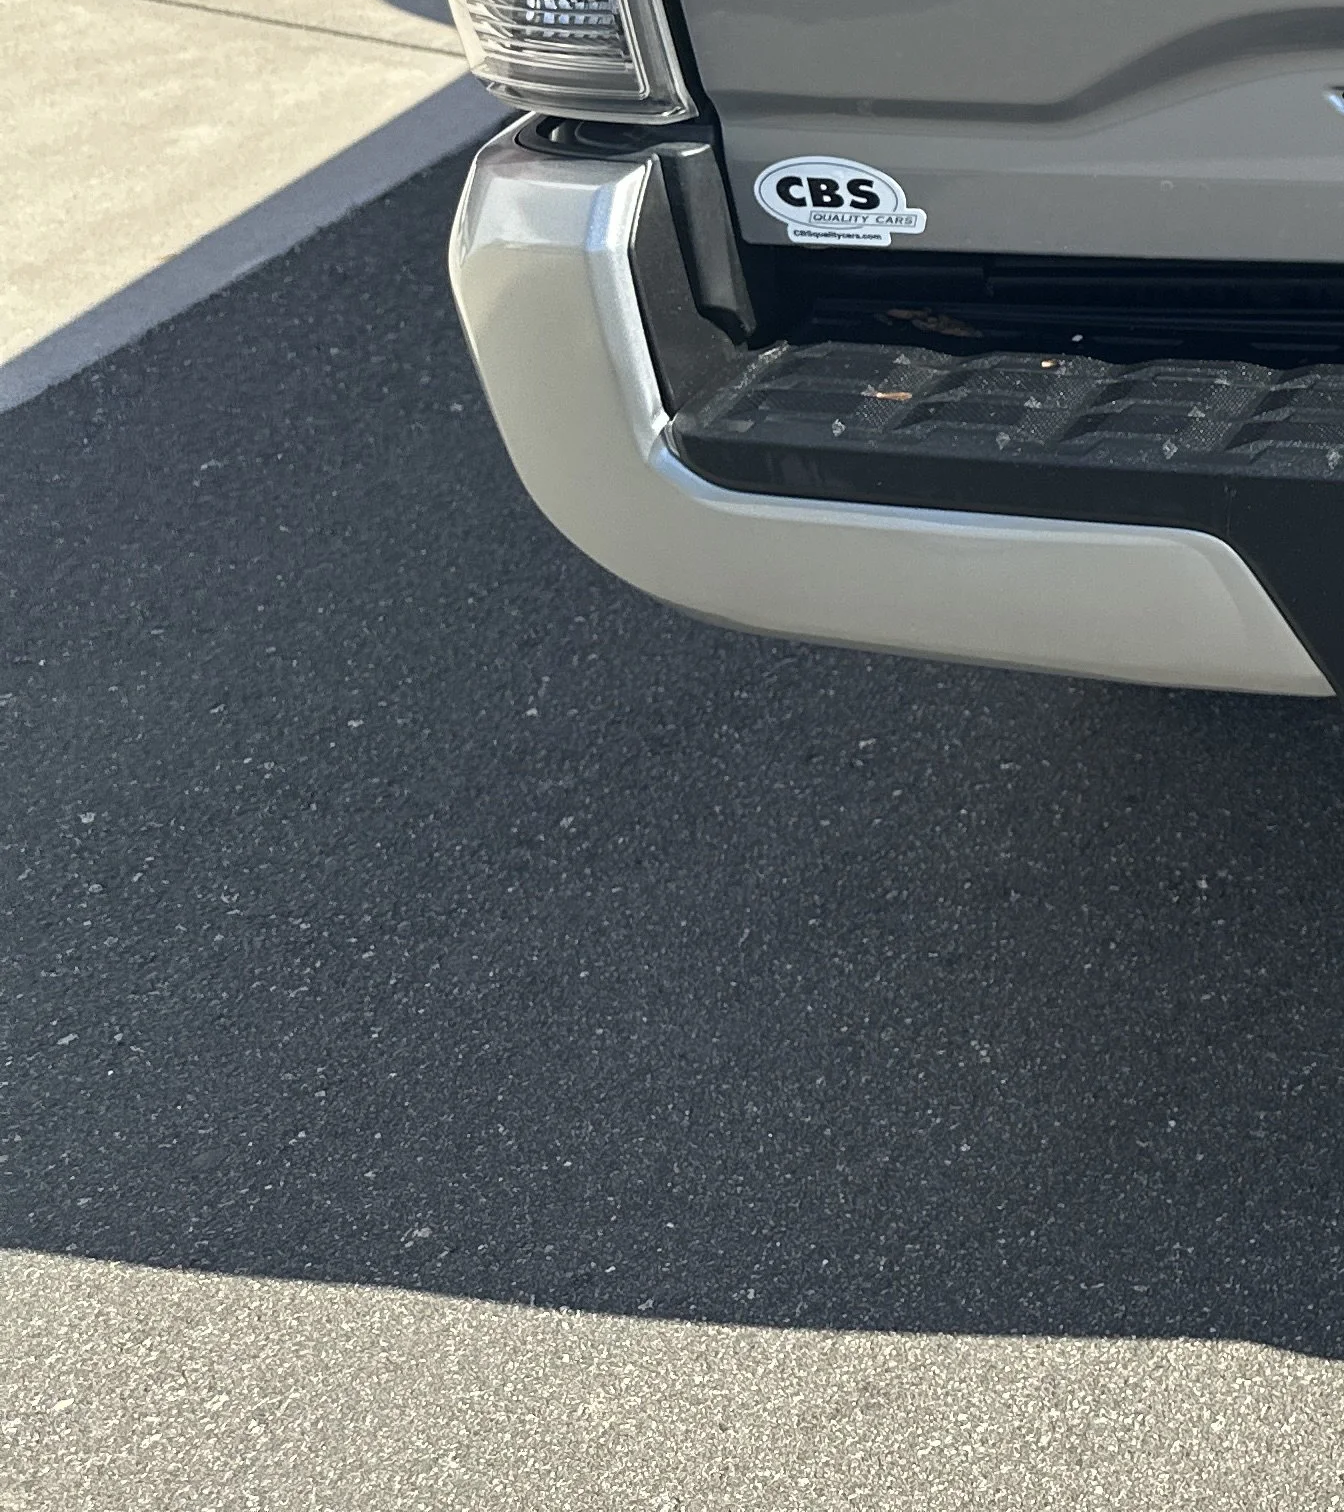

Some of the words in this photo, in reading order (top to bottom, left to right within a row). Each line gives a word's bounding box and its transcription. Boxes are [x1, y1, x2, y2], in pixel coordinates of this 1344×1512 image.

[776, 176, 880, 210] CBS
[813, 213, 869, 224] QUALITY
[875, 215, 913, 225] CARS
